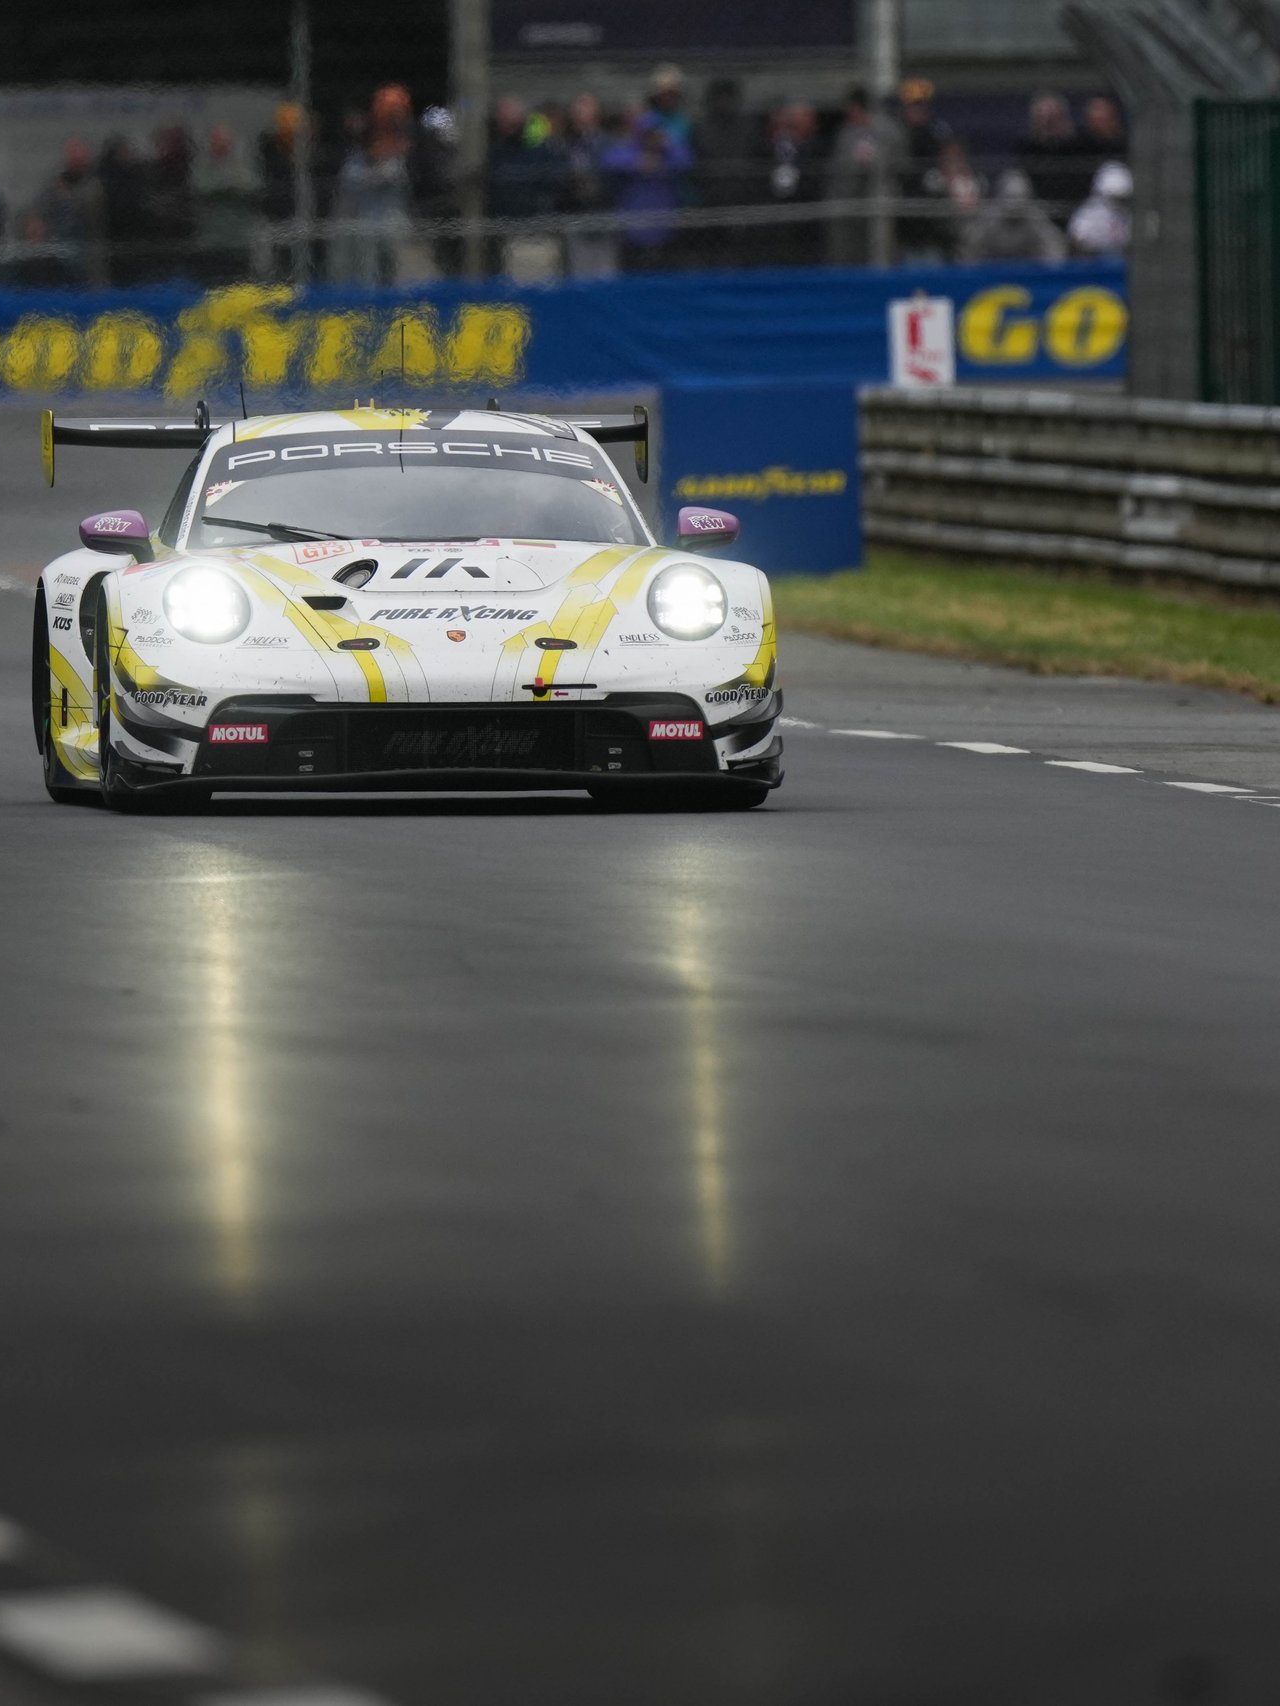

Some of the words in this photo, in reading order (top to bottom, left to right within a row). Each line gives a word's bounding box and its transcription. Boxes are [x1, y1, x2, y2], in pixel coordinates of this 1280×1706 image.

[228, 441, 594, 470] PORSCHE
[370, 607, 435, 621] PURE
[240, 635, 290, 645] ENDLESS
[619, 633, 661, 643] ENDLESS
[134, 688, 208, 707] GOODYEAR
[704, 684, 770, 703] GOODYEAR
[211, 727, 265, 741] MOTUL
[651, 723, 702, 737] MOTUL
